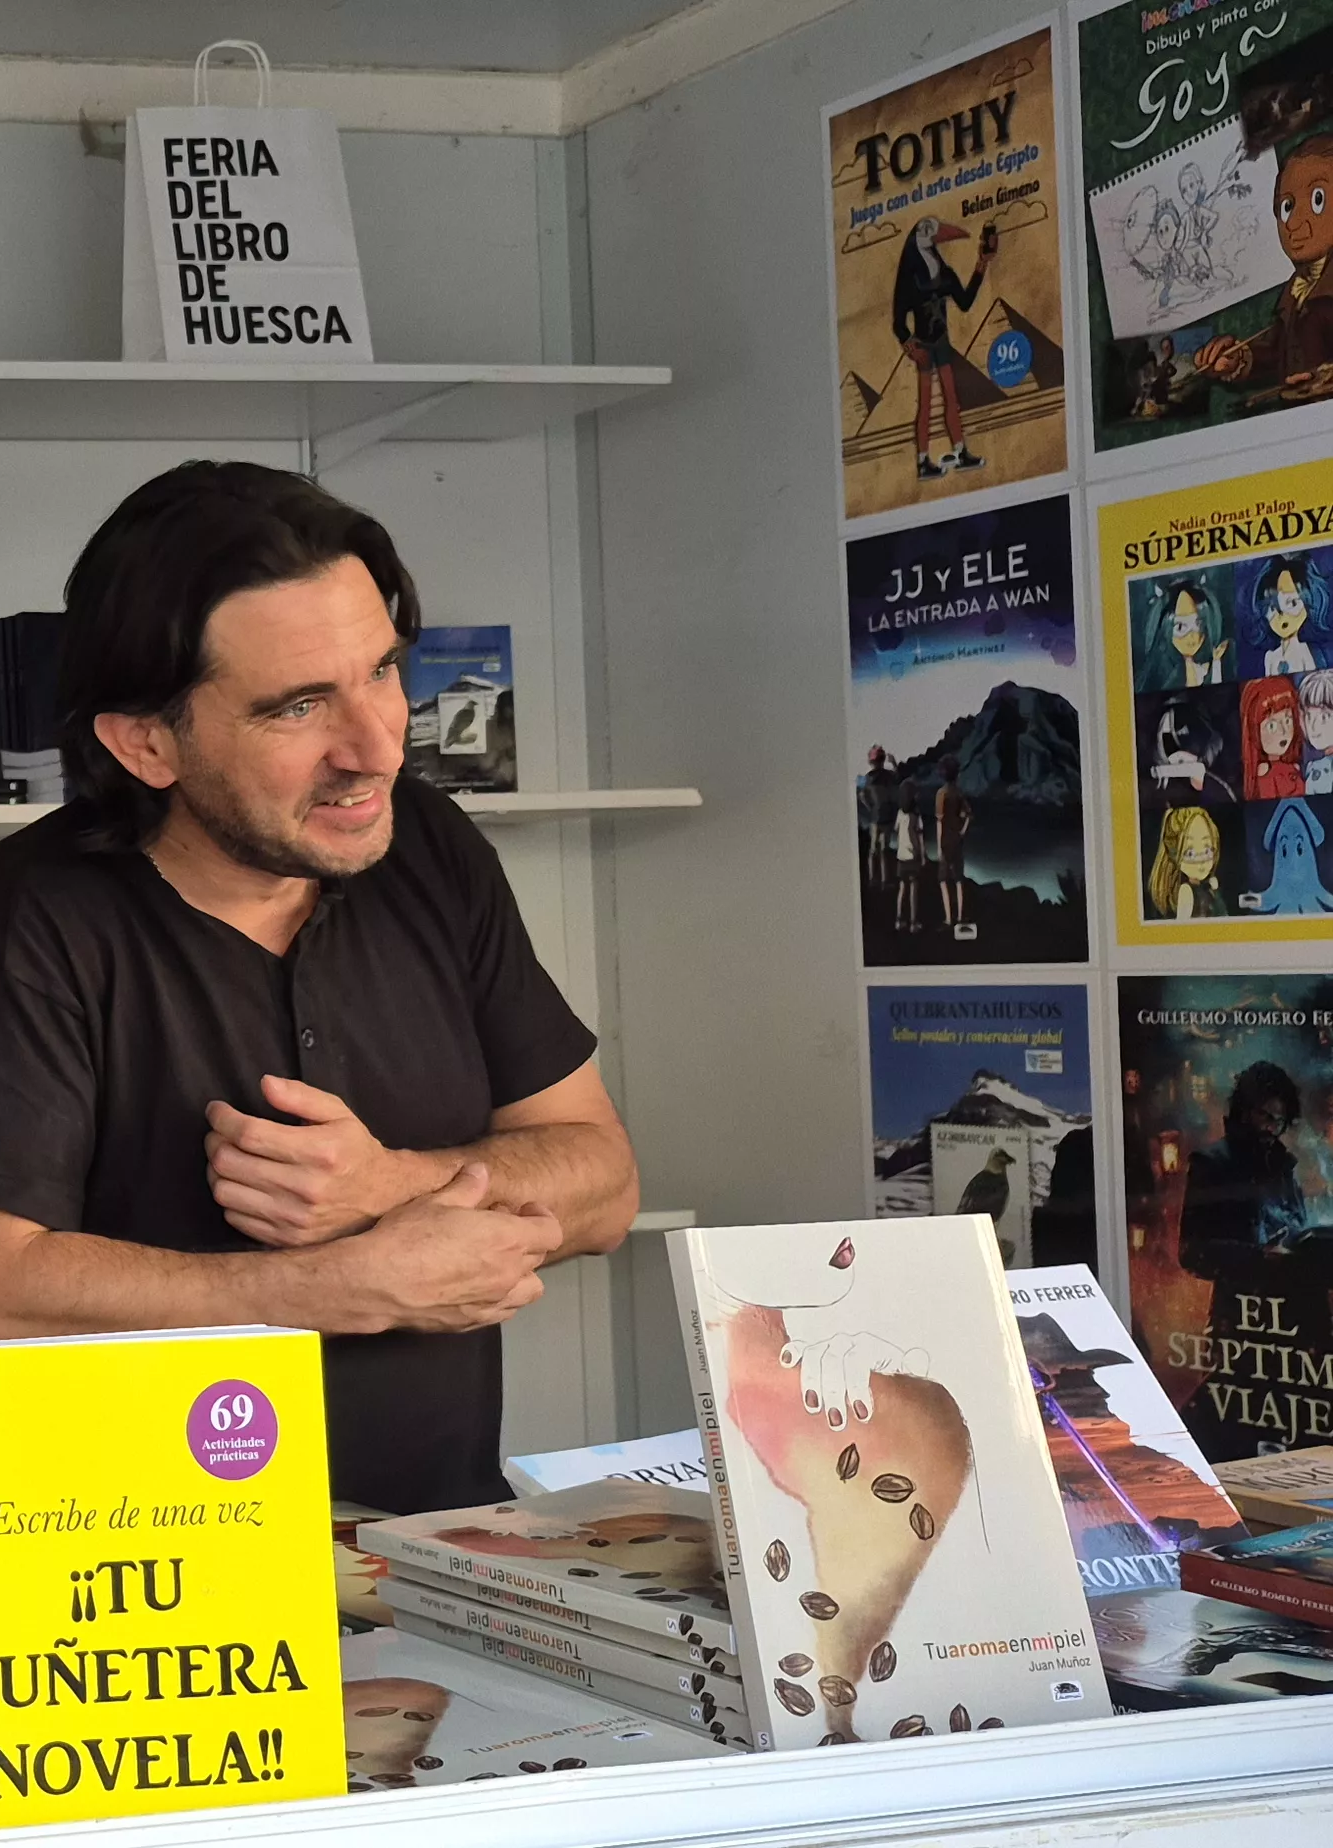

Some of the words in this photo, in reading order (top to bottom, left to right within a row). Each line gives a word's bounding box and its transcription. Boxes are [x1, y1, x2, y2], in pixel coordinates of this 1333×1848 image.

[1145, 27, 1191, 55] Dibuja
[1196, 22, 1206, 39] y
[1211, 6, 1249, 34] pinta
[163, 137, 279, 177] FERIA
[854, 91, 1017, 193] TOTHY
[925, 176, 952, 199] arte
[954, 161, 993, 187] desde
[996, 144, 1039, 177] Egipto
[167, 179, 242, 220] DEL
[172, 221, 290, 262] LIBRO
[178, 263, 230, 303] DE
[183, 305, 353, 345] HUESCA
[997, 338, 1019, 365] 96
[1210, 507, 1251, 526] Ornat
[1255, 499, 1296, 518] Palop
[884, 563, 924, 602] JJ
[962, 543, 1030, 588] ELE
[868, 612, 891, 633] LA
[894, 596, 982, 630] ENTRADA
[986, 593, 1000, 612] A
[1003, 583, 1051, 608] WAN
[1137, 1009, 1227, 1026] GUILLERMO
[1233, 1009, 1307, 1027] ROMERO
[1033, 1283, 1096, 1303] FERRER
[690, 1308, 705, 1347] Muñoz
[1234, 1293, 1300, 1337] EL
[699, 1345, 710, 1375] Juan
[210, 1393, 254, 1431] 69
[1207, 1383, 1333, 1445] VIAJE
[201, 1437, 266, 1451] Actividades
[209, 1449, 260, 1465] prácticas
[699, 1390, 741, 1581] Tuaromaenmipiel
[108, 1495, 140, 1530] de
[151, 1501, 207, 1530] una
[217, 1497, 265, 1529] vez
[69, 1557, 184, 1624] ¡¡TU
[448, 1554, 569, 1603] Tuaromaenmipiel
[1209, 1577, 1260, 1597] GUILLERMO
[1260, 1588, 1300, 1606] ROMERO
[465, 1609, 583, 1661] Tuaromaenmipiel
[923, 1627, 1087, 1662] Tuaromaenmipiel
[1028, 1656, 1055, 1673] Juan
[1055, 1653, 1092, 1671] Muñoz
[759, 1733, 770, 1746] S
